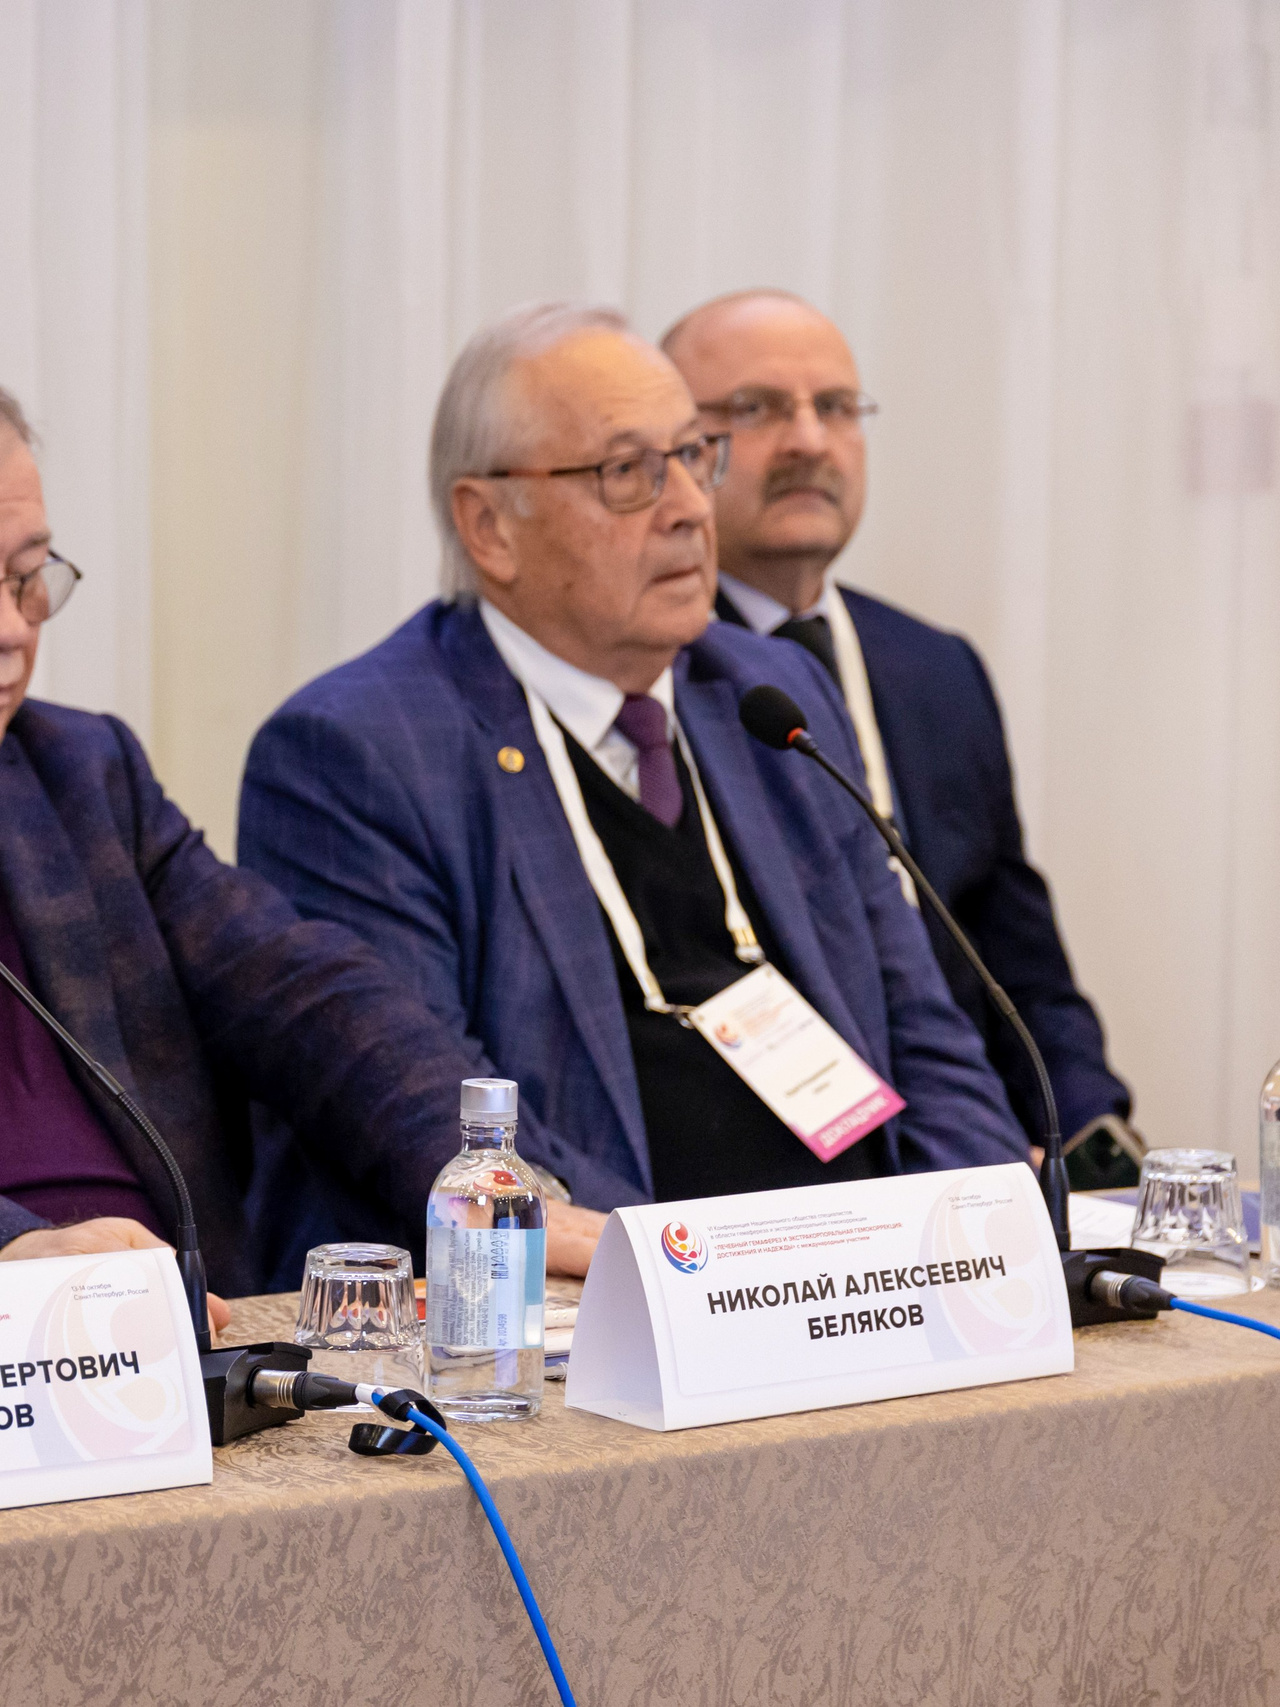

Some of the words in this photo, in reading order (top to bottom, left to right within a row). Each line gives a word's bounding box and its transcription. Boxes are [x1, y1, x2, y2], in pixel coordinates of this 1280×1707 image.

[707, 1273, 836, 1314] НИКОЛАЙ
[845, 1255, 1005, 1296] АЛЕКСЕЕВИЧ
[807, 1304, 924, 1339] БЕЛЯКОВ
